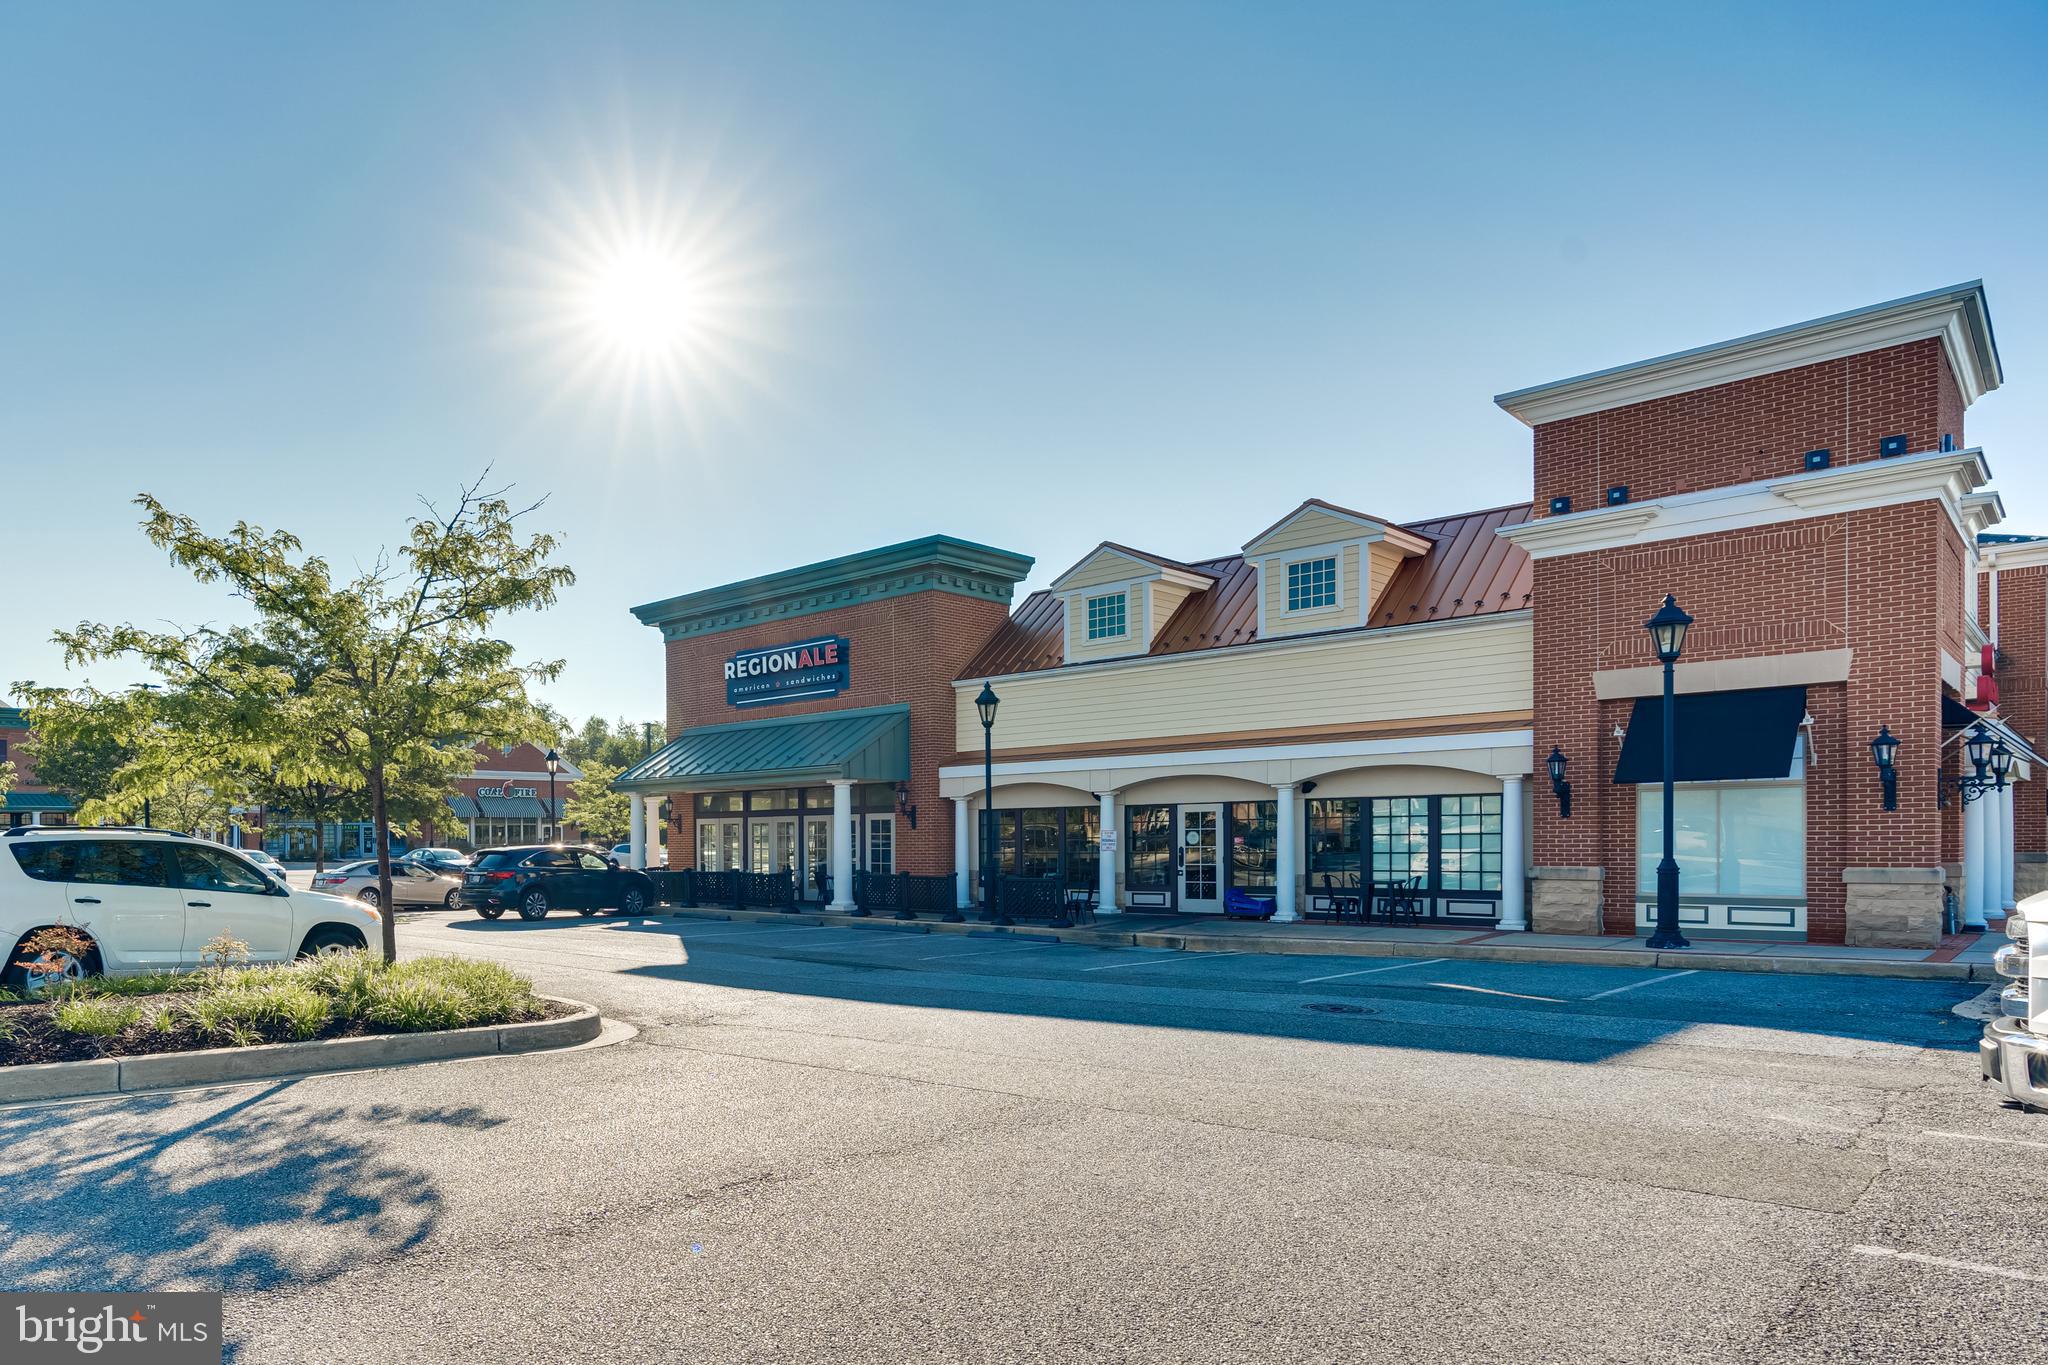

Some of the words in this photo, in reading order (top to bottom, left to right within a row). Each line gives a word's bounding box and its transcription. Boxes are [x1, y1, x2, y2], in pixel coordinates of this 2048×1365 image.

[724, 644, 839, 680] REGIONALE
[733, 683, 770, 693] american
[785, 673, 836, 686] sandwiches
[478, 787, 503, 797] COAL
[514, 787, 537, 798] FIRE
